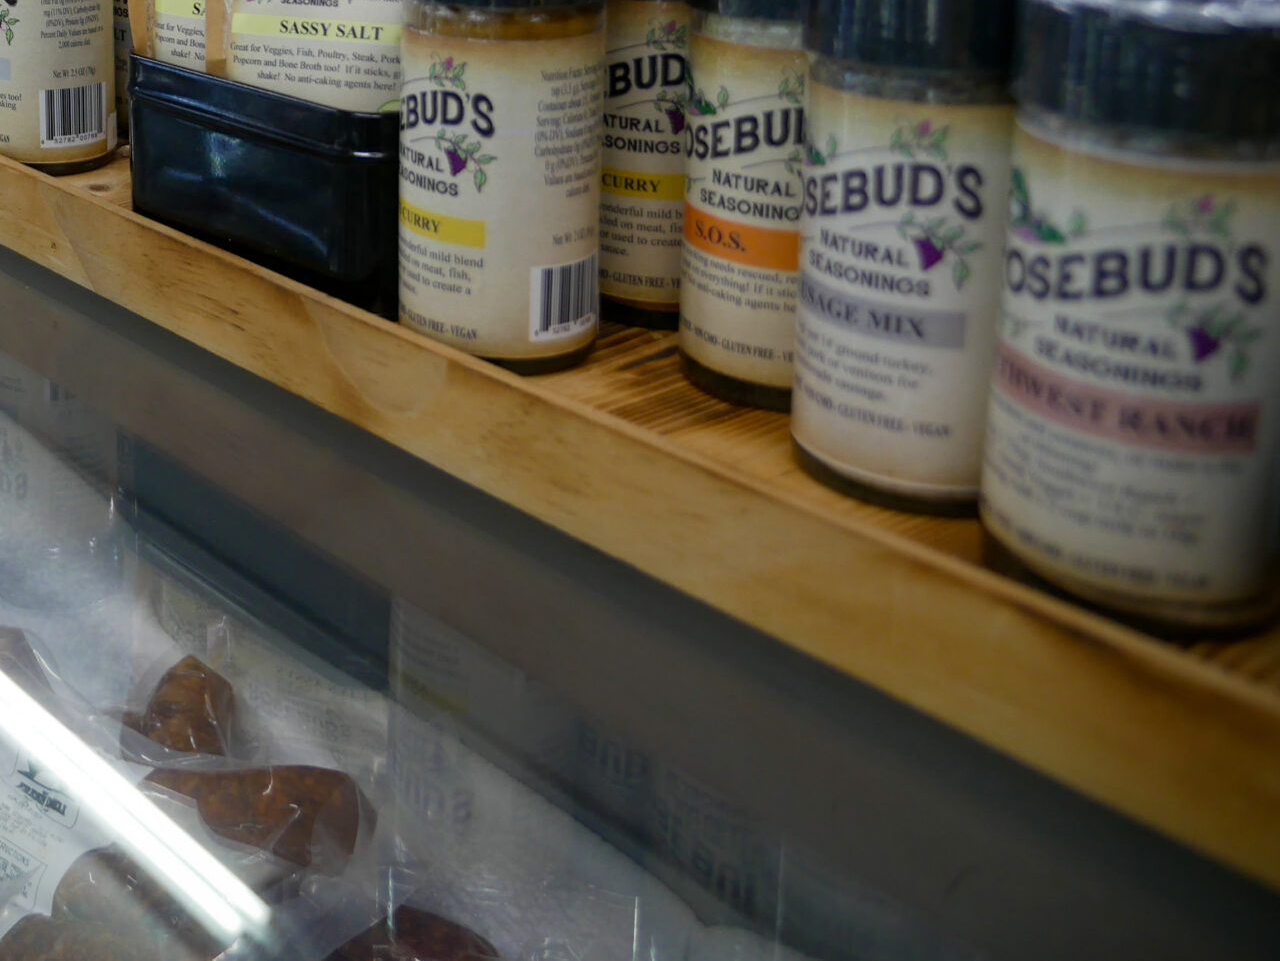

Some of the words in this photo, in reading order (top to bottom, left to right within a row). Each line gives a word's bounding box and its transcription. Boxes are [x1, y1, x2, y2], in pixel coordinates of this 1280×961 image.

[280, 20, 332, 36] SASSY
[336, 24, 384, 40] SALT
[230, 43, 248, 51] Great
[251, 43, 260, 52] for
[296, 47, 315, 58] Fish,
[318, 49, 349, 61] Poultry,
[352, 52, 377, 63] Steak,
[233, 55, 262, 66] Popcorn
[264, 58, 276, 67] and
[279, 60, 298, 69] Bone
[300, 61, 321, 71] Broth
[324, 64, 340, 72] too!
[345, 65, 352, 73] If
[355, 66, 361, 74] it
[363, 67, 390, 79] sticks,
[257, 71, 280, 81] shake!
[285, 73, 295, 82] No
[298, 74, 341, 87] anti-caking
[344, 80, 371, 90] agents
[373, 82, 396, 91] here!
[7, 93, 22, 102] too!
[712, 168, 796, 197] NATURAL
[646, 209, 671, 219] mild
[700, 188, 800, 221] SEASONING
[620, 221, 633, 229] on
[636, 223, 666, 234] meat,
[695, 219, 745, 252] S.O.S.
[611, 232, 634, 244] used
[637, 236, 648, 245] to
[821, 229, 910, 267] NATURAL
[429, 251, 451, 264] mild
[454, 254, 483, 269] blend
[449, 267, 471, 282] fish,
[613, 271, 643, 285] GLUTEN
[645, 276, 664, 288] FREE
[738, 269, 782, 284] rescued,
[809, 249, 931, 297] SEASONINGS
[432, 280, 462, 293] create
[745, 298, 780, 310] agents
[868, 310, 924, 339] MIX
[722, 338, 751, 355] GLUTEN
[753, 347, 774, 359] FREE
